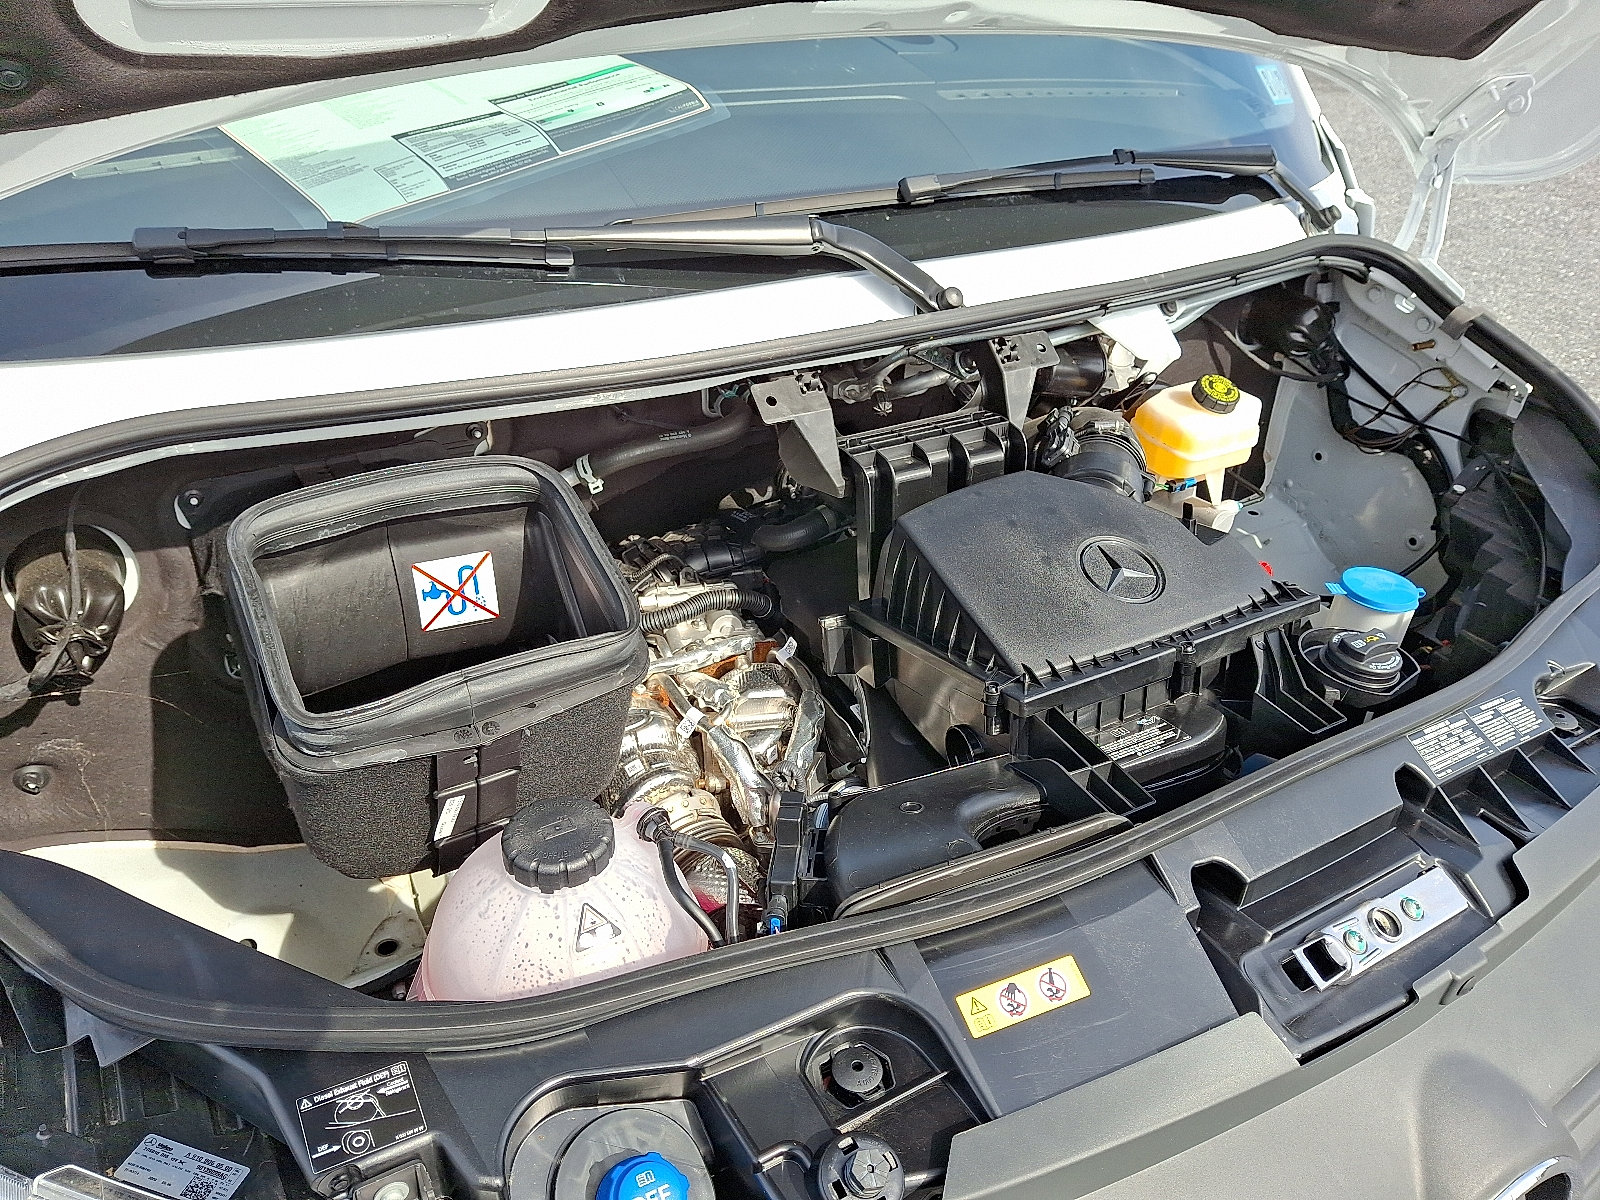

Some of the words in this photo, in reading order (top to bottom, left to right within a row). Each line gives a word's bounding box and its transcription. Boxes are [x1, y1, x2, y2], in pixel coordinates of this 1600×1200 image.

[313, 1092, 333, 1103] Diesel
[334, 1084, 358, 1096] Exhaust
[358, 1078, 372, 1089] Fluid
[374, 1072, 390, 1082] (DEF)
[318, 1144, 328, 1152] DEF
